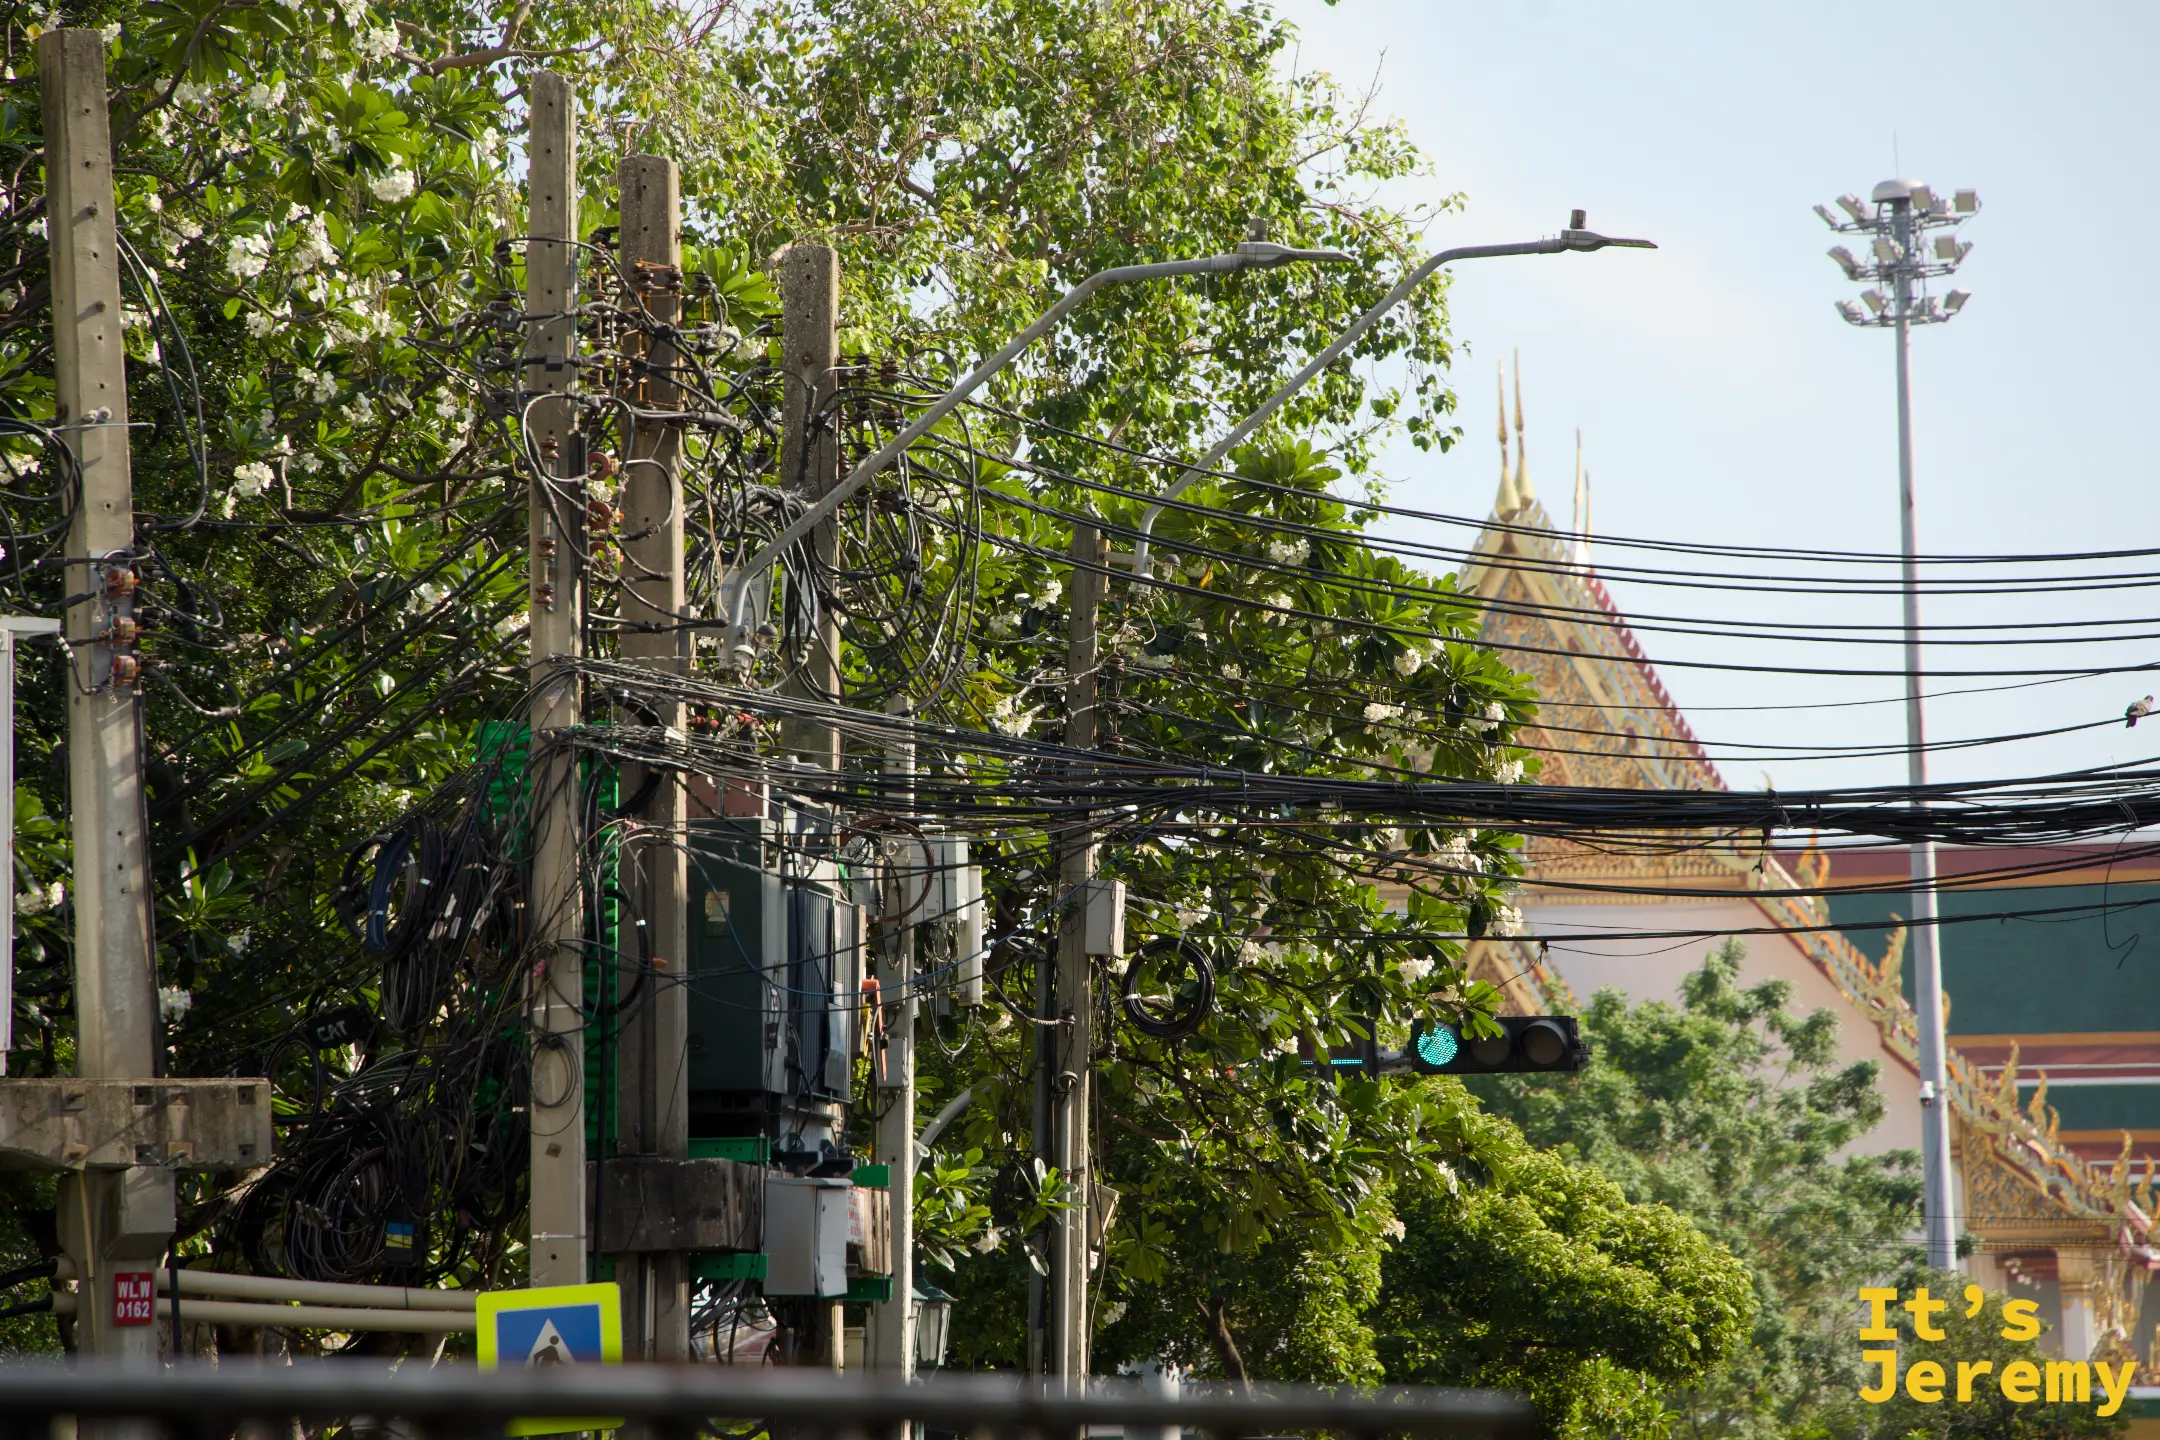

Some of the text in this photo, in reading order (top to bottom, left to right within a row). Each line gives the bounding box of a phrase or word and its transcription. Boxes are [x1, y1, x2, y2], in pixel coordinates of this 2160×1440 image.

[316, 1020, 347, 1042] CAT
[118, 1281, 150, 1298] WLW
[117, 1301, 150, 1318] 0162
